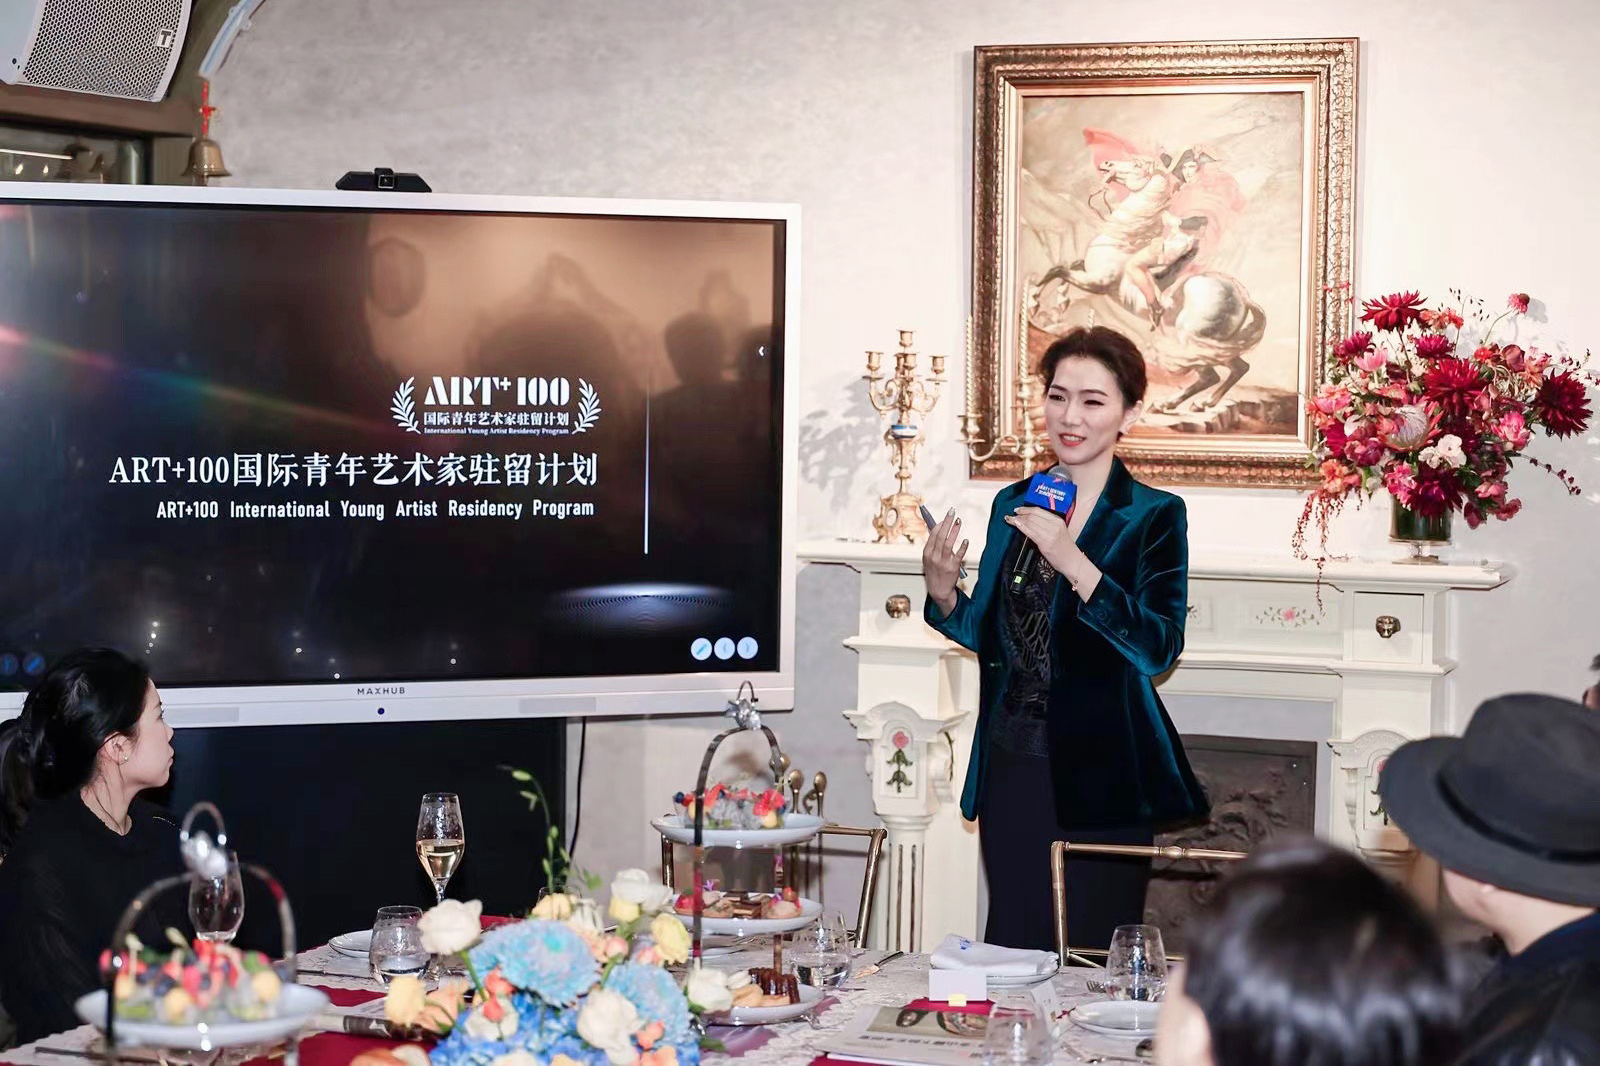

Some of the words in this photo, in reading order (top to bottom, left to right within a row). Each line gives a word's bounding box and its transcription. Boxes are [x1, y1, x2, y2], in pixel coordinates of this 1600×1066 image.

[423, 411, 570, 426] 国际青年艺术家驻留计划
[467, 427, 489, 436] Young
[508, 427, 541, 436] Residency
[541, 427, 570, 436] Program
[108, 451, 598, 487] ART+100国际青年艺术家驻留计划
[156, 500, 219, 519] ART+100
[230, 500, 331, 518] International
[340, 500, 385, 521] Young
[395, 500, 438, 517] Artist
[448, 499, 523, 520] Residency
[532, 499, 594, 520] Program
[357, 687, 405, 695] MAXHUB
